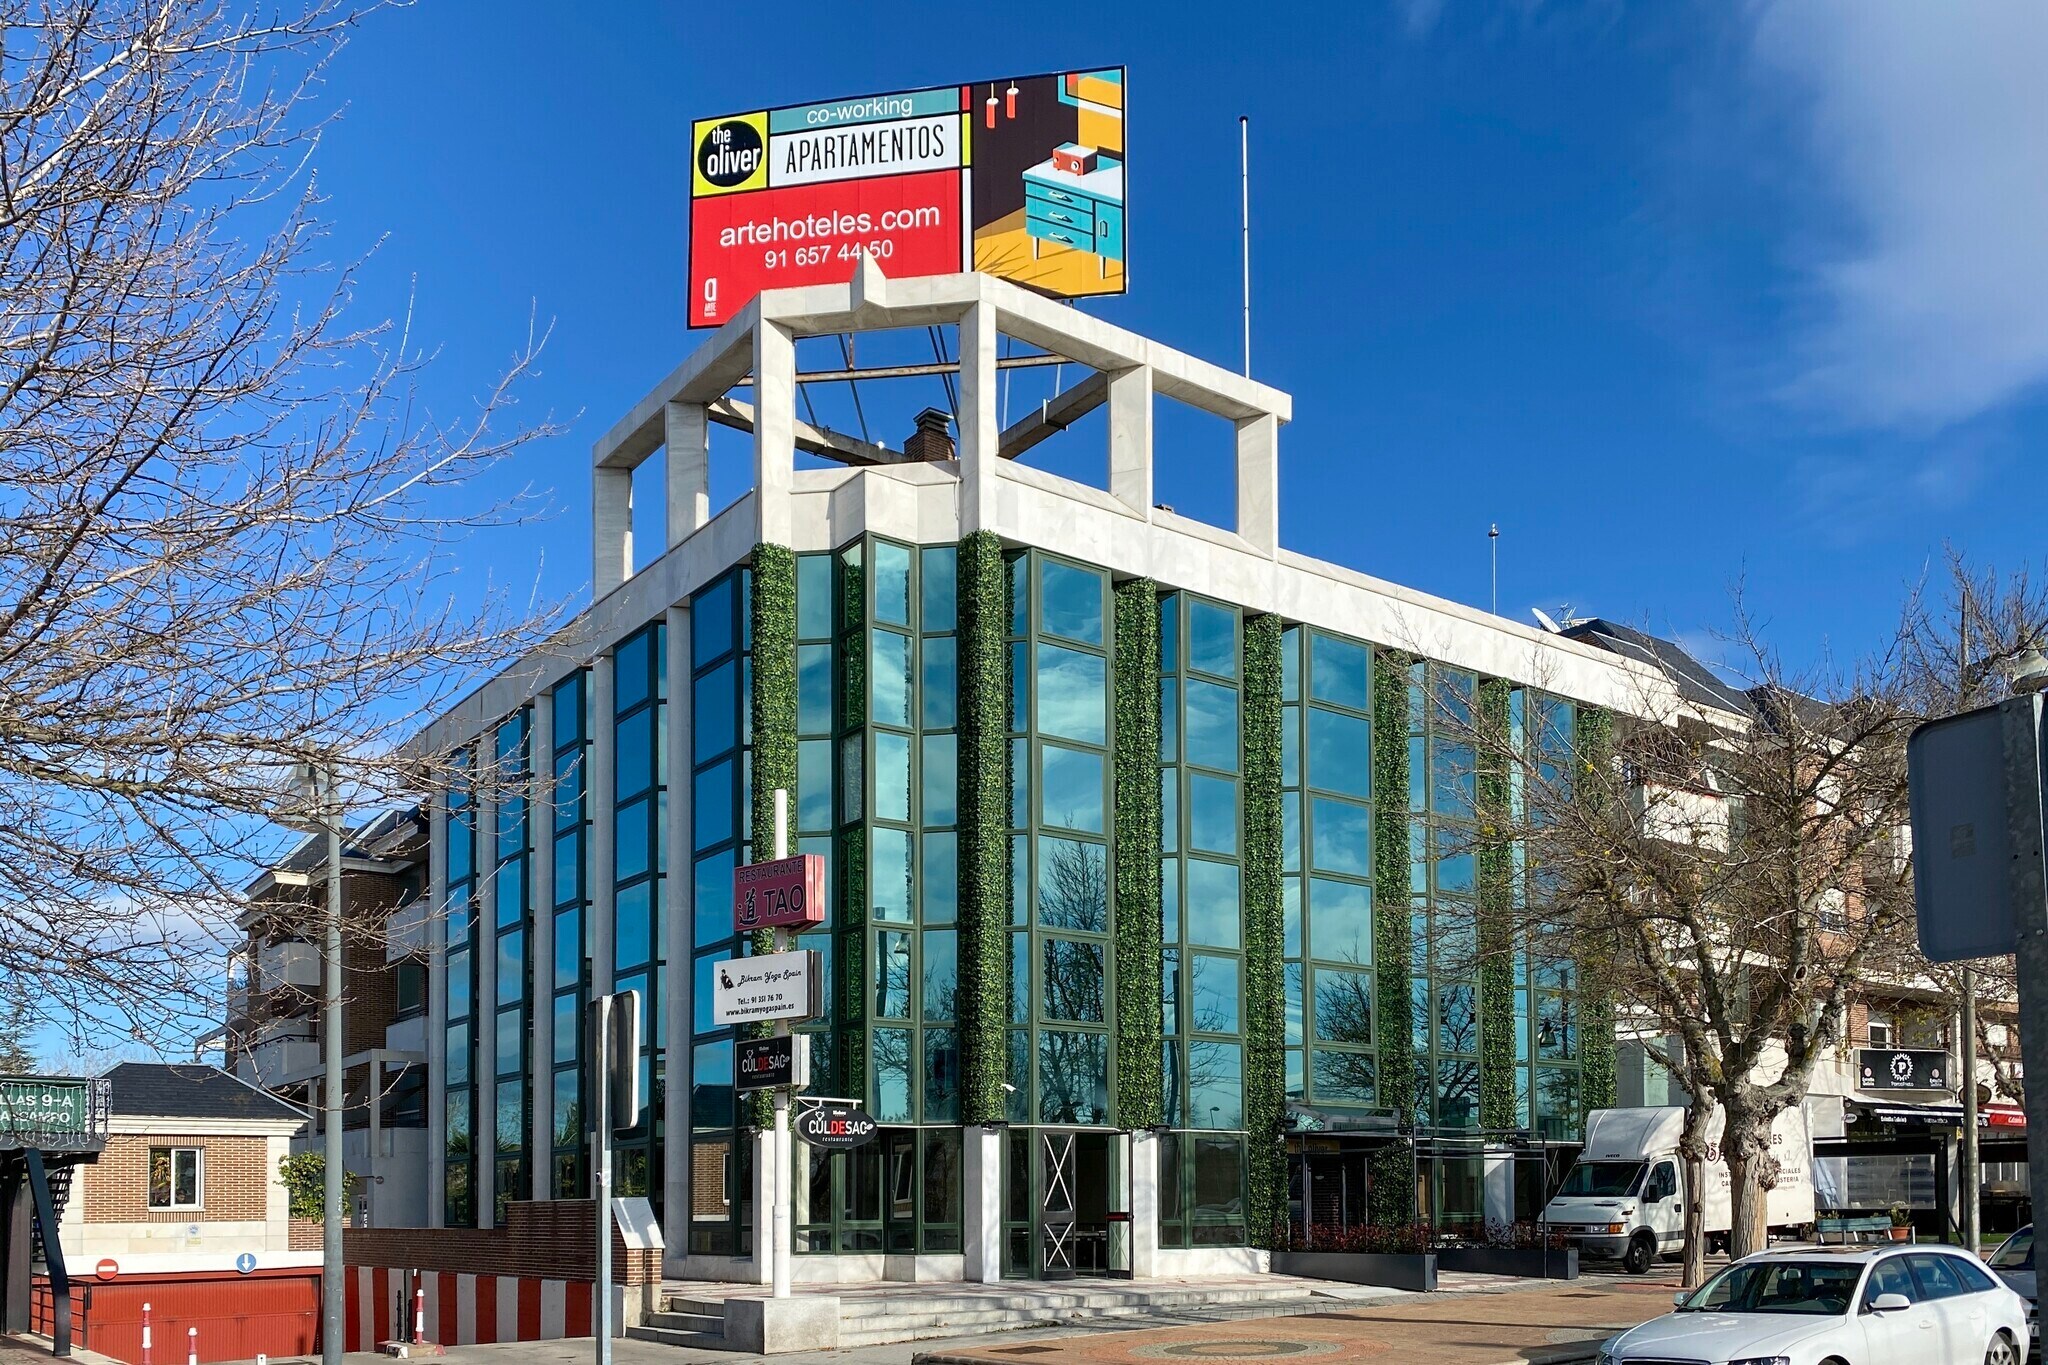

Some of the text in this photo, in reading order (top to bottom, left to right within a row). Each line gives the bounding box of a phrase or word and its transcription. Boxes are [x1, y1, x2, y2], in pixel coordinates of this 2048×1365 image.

[807, 97, 913, 124] co-working
[712, 125, 731, 145] the
[786, 124, 944, 174] APARTAMENTOS
[707, 144, 761, 176] oliver
[719, 206, 940, 247] artehoteles.com
[764, 249, 787, 269] 91
[795, 245, 831, 266] 657
[869, 239, 893, 260] 50
[739, 860, 803, 883] RESTAURANTE
[763, 884, 805, 917] TAO
[764, 971, 782, 984] Yoga
[783, 969, 802, 981] Spain
